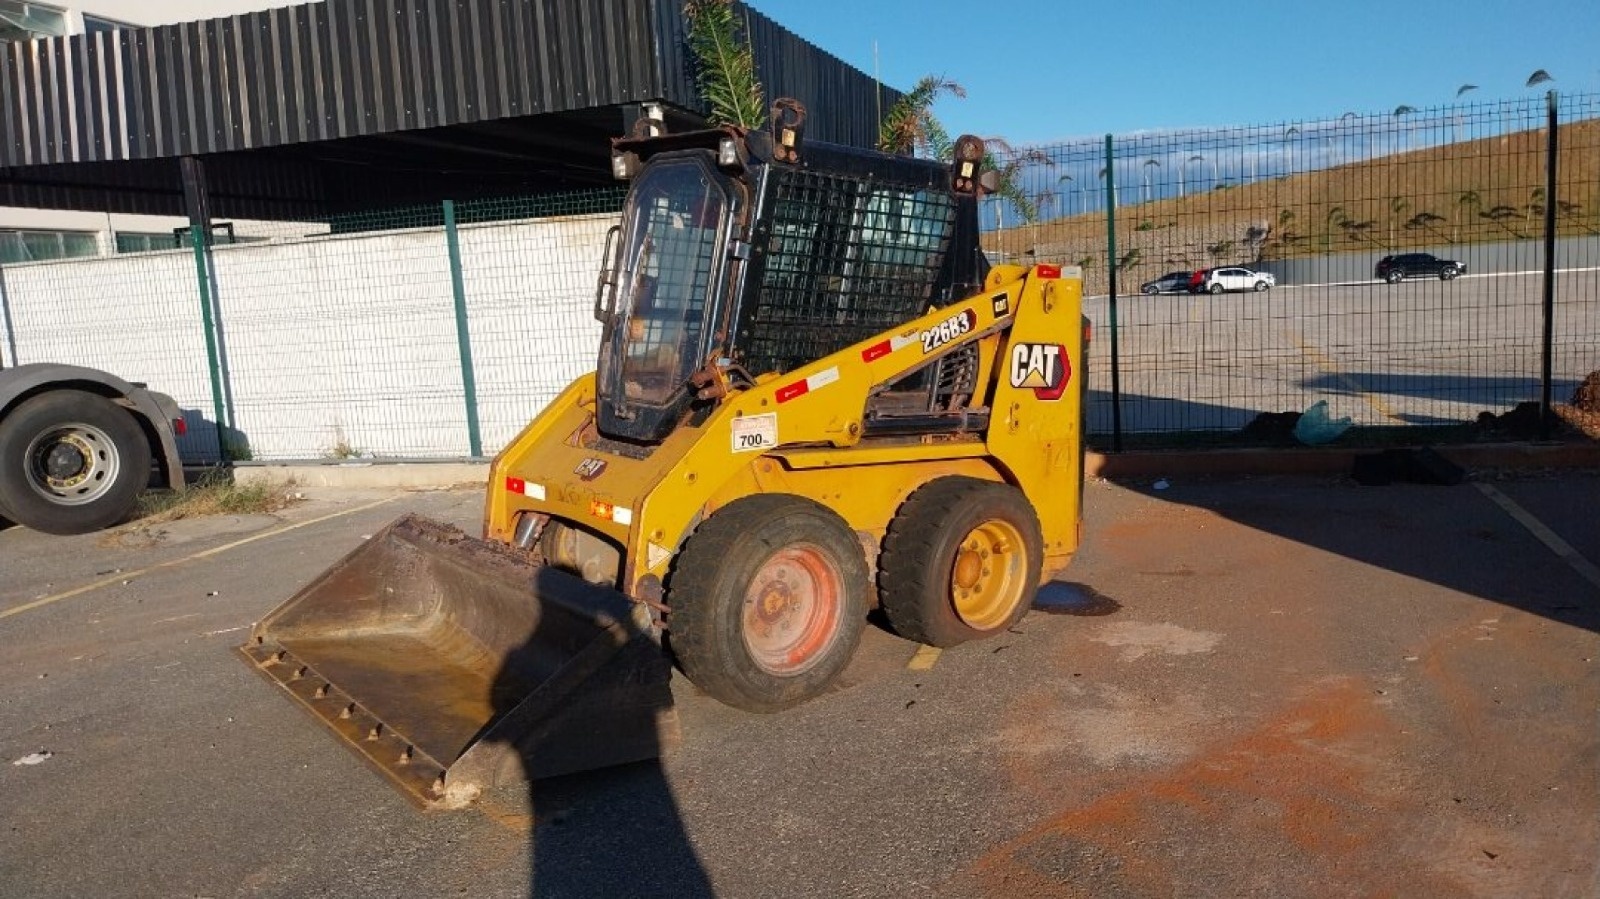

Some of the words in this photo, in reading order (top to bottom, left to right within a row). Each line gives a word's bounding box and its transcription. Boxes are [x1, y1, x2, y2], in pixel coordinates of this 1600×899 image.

[994, 298, 1008, 313] CAT
[921, 311, 971, 354] 226B3
[1011, 344, 1059, 388] CAT
[740, 433, 762, 447] 700
[574, 457, 605, 477] CAT
